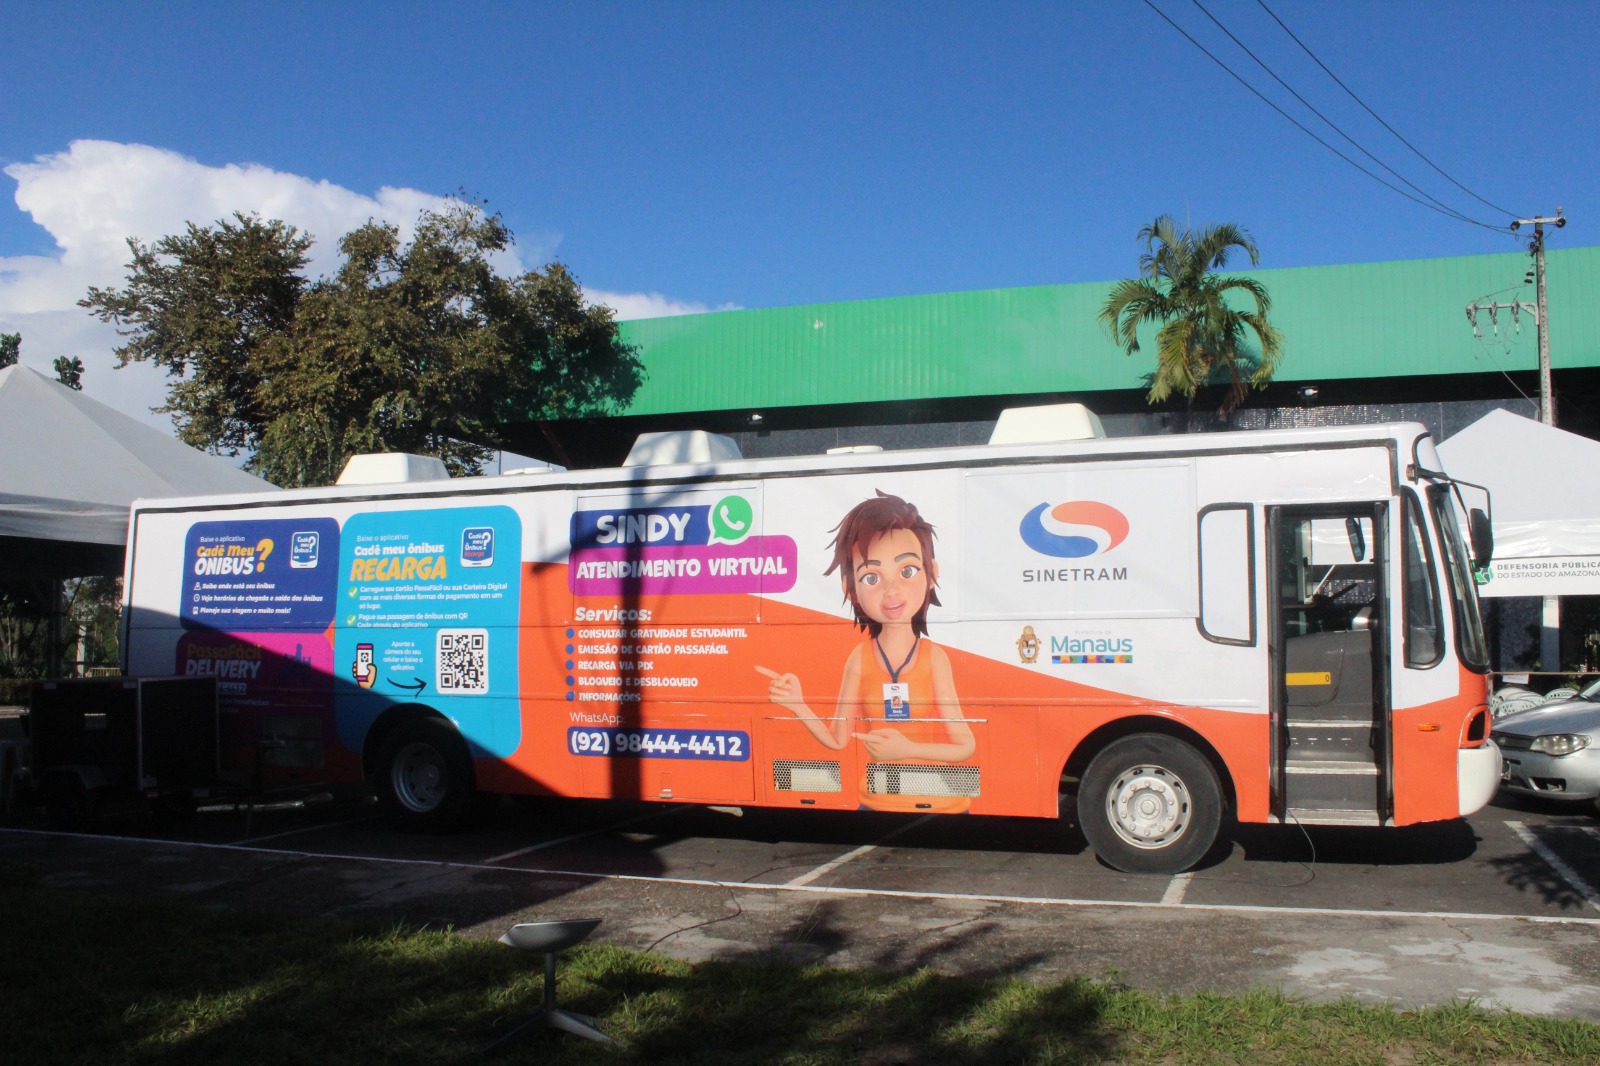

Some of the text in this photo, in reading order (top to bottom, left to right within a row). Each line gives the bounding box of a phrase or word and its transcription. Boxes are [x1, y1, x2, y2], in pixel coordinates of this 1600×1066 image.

[596, 512, 691, 544] SINDY
[380, 534, 409, 542] aplicativo
[197, 545, 225, 557] Cadê
[354, 544, 444, 556] Cadê meu ônibus
[350, 556, 447, 582] RECARGA
[576, 556, 788, 579] ATENDIMENTO VIRTUAL
[1022, 567, 1128, 582] SINETRAM
[488, 582, 508, 590] Digital
[574, 605, 652, 624] Serviços:
[578, 628, 747, 639] CONSULTAR GRATUIDADE ESTUDANTIL
[578, 642, 728, 654] EMISSÃO DE CARTÃO PASSAFÁCIL
[1051, 636, 1133, 653] Manaus
[186, 659, 261, 679] DELIVERY
[578, 661, 654, 670] RECARGA VIA PIX
[578, 677, 698, 687] BLOQUEIO E DESBLOQUEIO
[579, 691, 641, 704] INFORMAÇÕES
[571, 731, 742, 756] (92) 98444-4412
